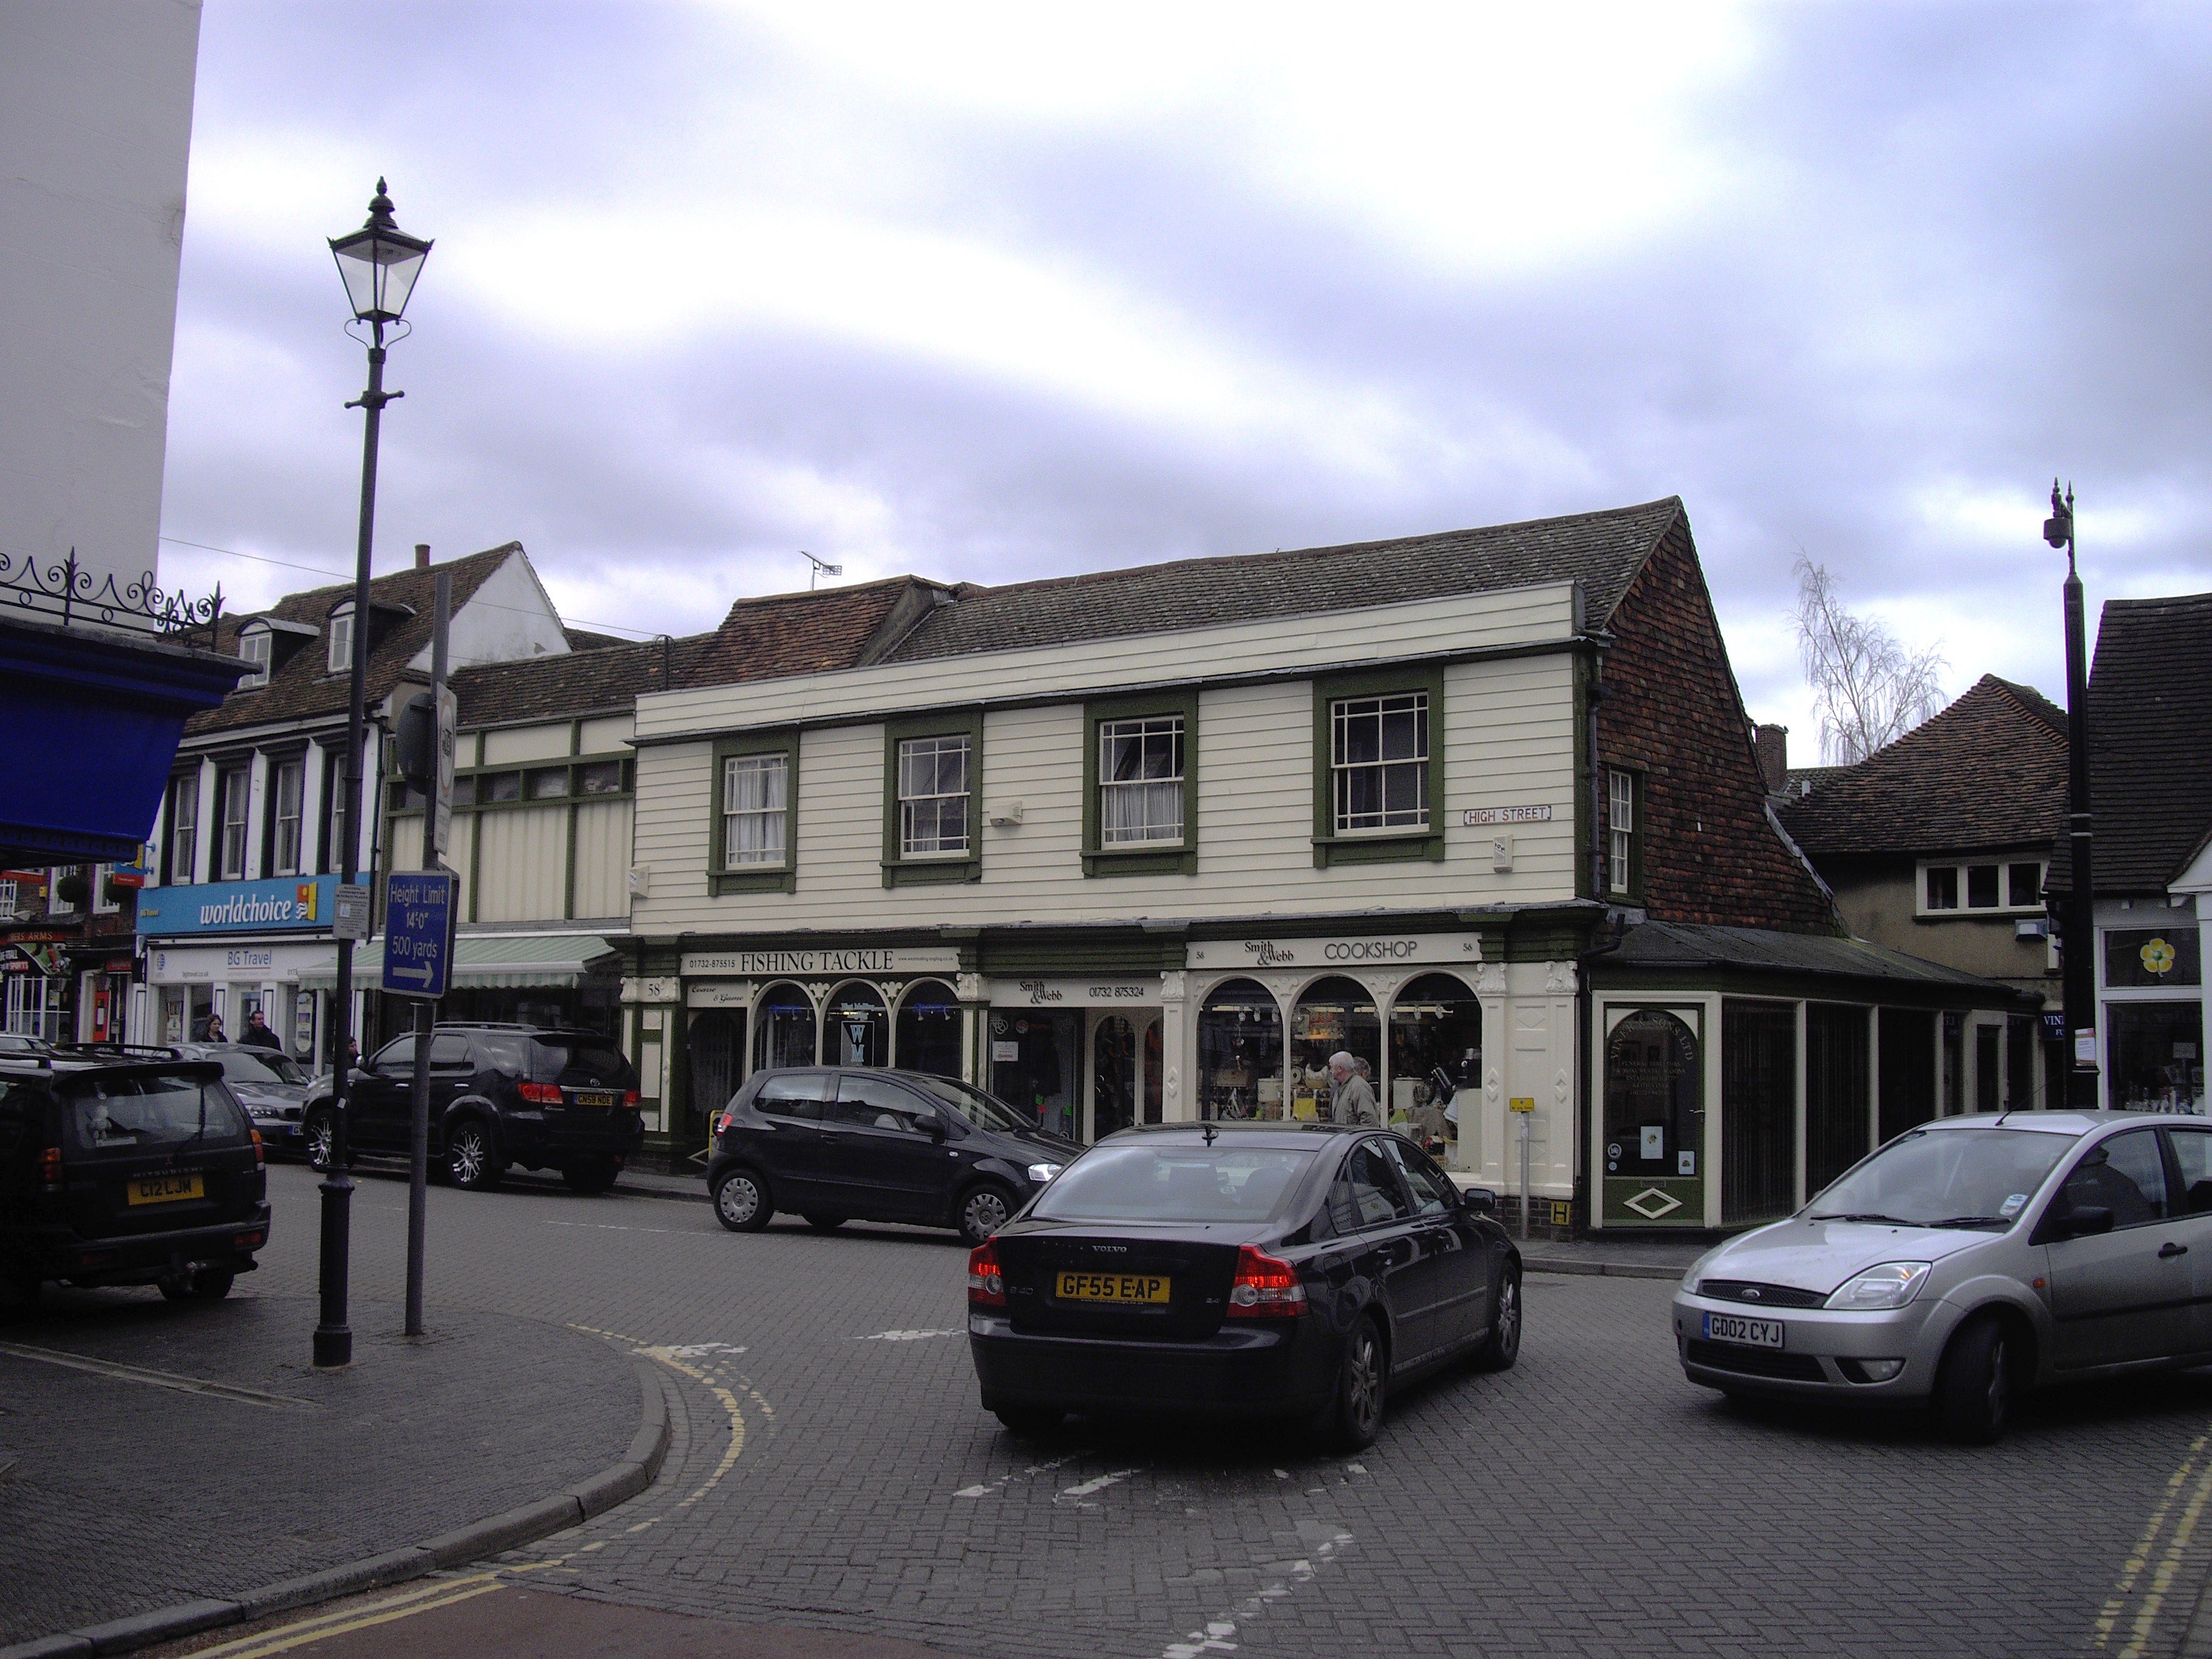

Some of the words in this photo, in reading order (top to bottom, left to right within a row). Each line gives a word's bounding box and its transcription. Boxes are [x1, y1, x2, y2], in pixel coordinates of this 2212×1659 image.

[1469, 810, 1495, 823] HIGH
[1502, 807, 1546, 821] STREET
[390, 884, 419, 907] Height
[422, 884, 445, 905] Limit
[200, 894, 291, 925] worldchoice
[28, 931, 54, 941] ARMS
[392, 935, 410, 956] 500
[412, 938, 438, 961] yards
[1244, 941, 1274, 953] Smith
[1324, 941, 1417, 959] COOKSHOP
[1463, 943, 1472, 951] 56
[227, 951, 240, 966] BG
[243, 950, 272, 965] Travel
[689, 959, 735, 968] 01732-875515
[741, 952, 813, 972] FISHING
[820, 951, 894, 971] TACKLE
[648, 984, 660, 996] 58
[691, 985, 717, 993] Coarse
[1019, 980, 1045, 992] Smith
[1089, 987, 1112, 997] 01732
[1114, 987, 1144, 997] 875324
[1652, 1016, 1681, 1036] SONS
[1679, 1036, 1693, 1060] LTD
[133, 1167, 202, 1178] MITSUBISHI
[140, 1182, 163, 1197] C12
[1553, 1203, 1567, 1222] H
[1063, 1275, 1115, 1297] GF55
[1120, 1277, 1160, 1299] EAP
[1712, 1317, 1746, 1339] GD02
[1750, 1323, 1779, 1343] CYJ
